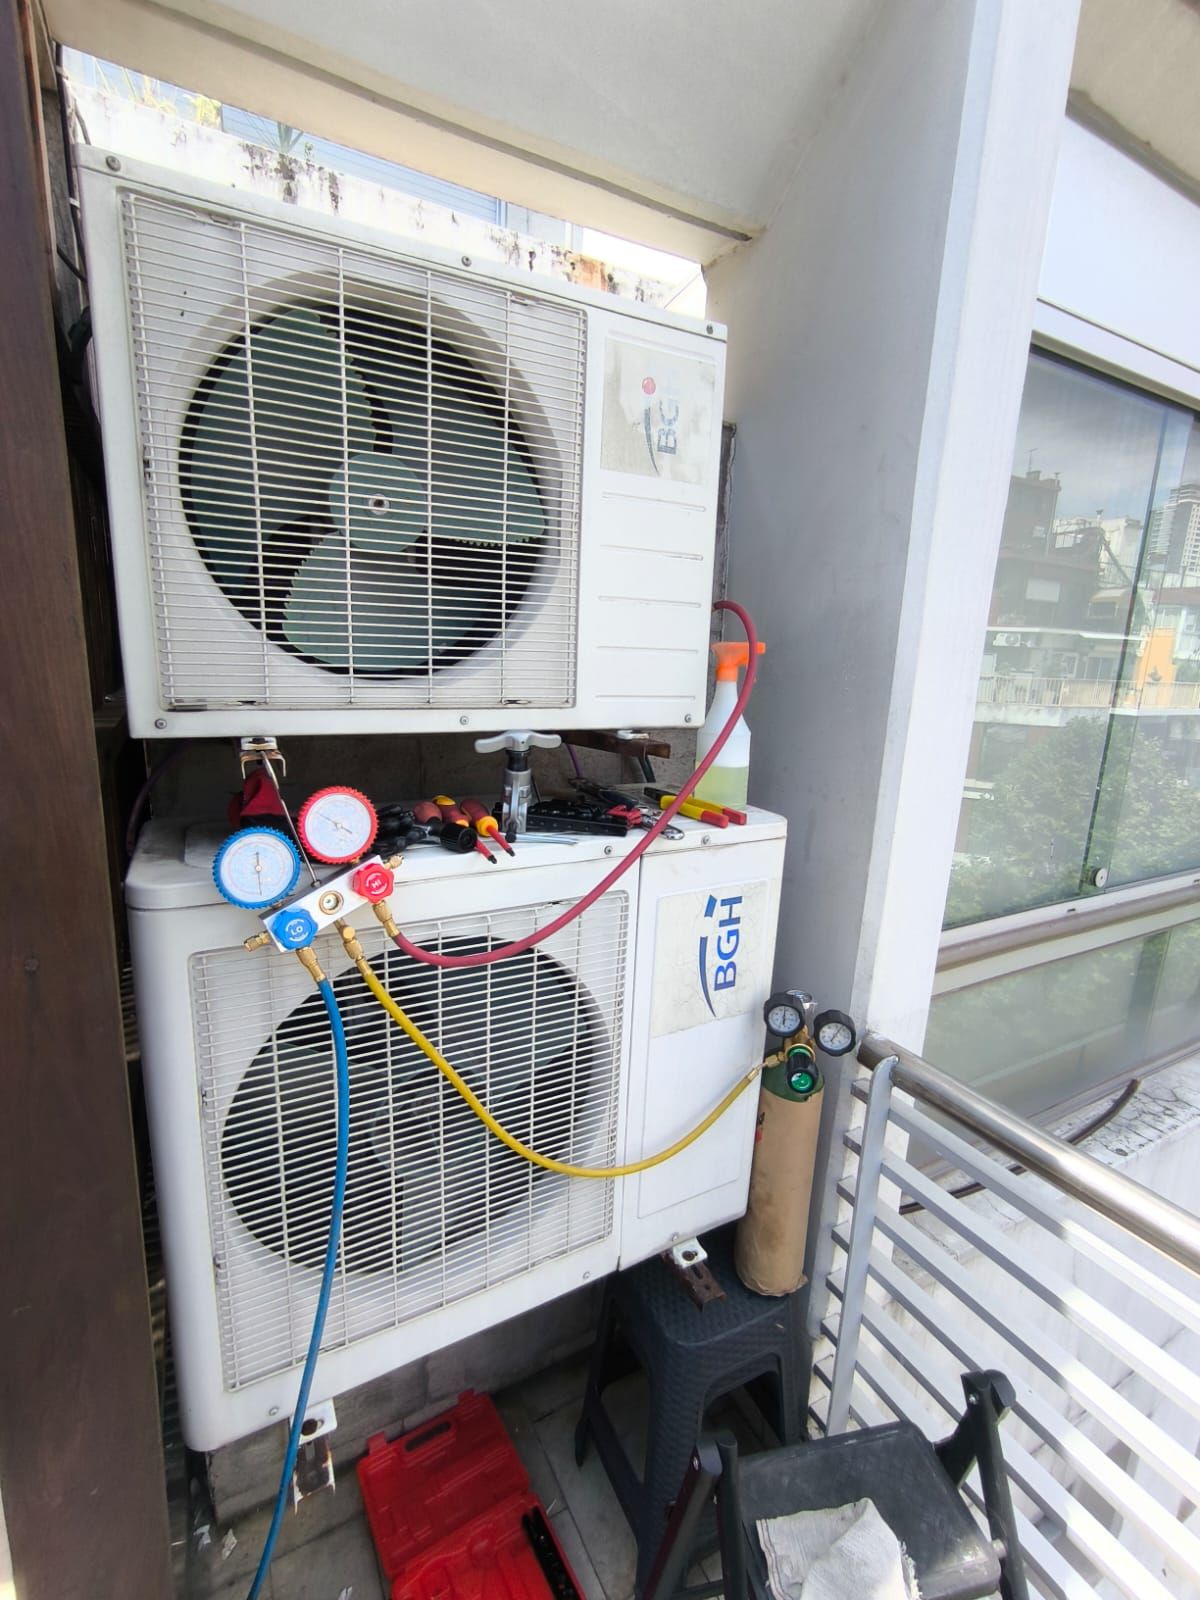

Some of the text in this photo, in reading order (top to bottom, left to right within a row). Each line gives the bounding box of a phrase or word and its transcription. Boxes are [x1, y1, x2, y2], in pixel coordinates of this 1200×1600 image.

[370, 879, 382, 889] HI
[290, 925, 304, 936] LO
[713, 895, 743, 991] BGH
